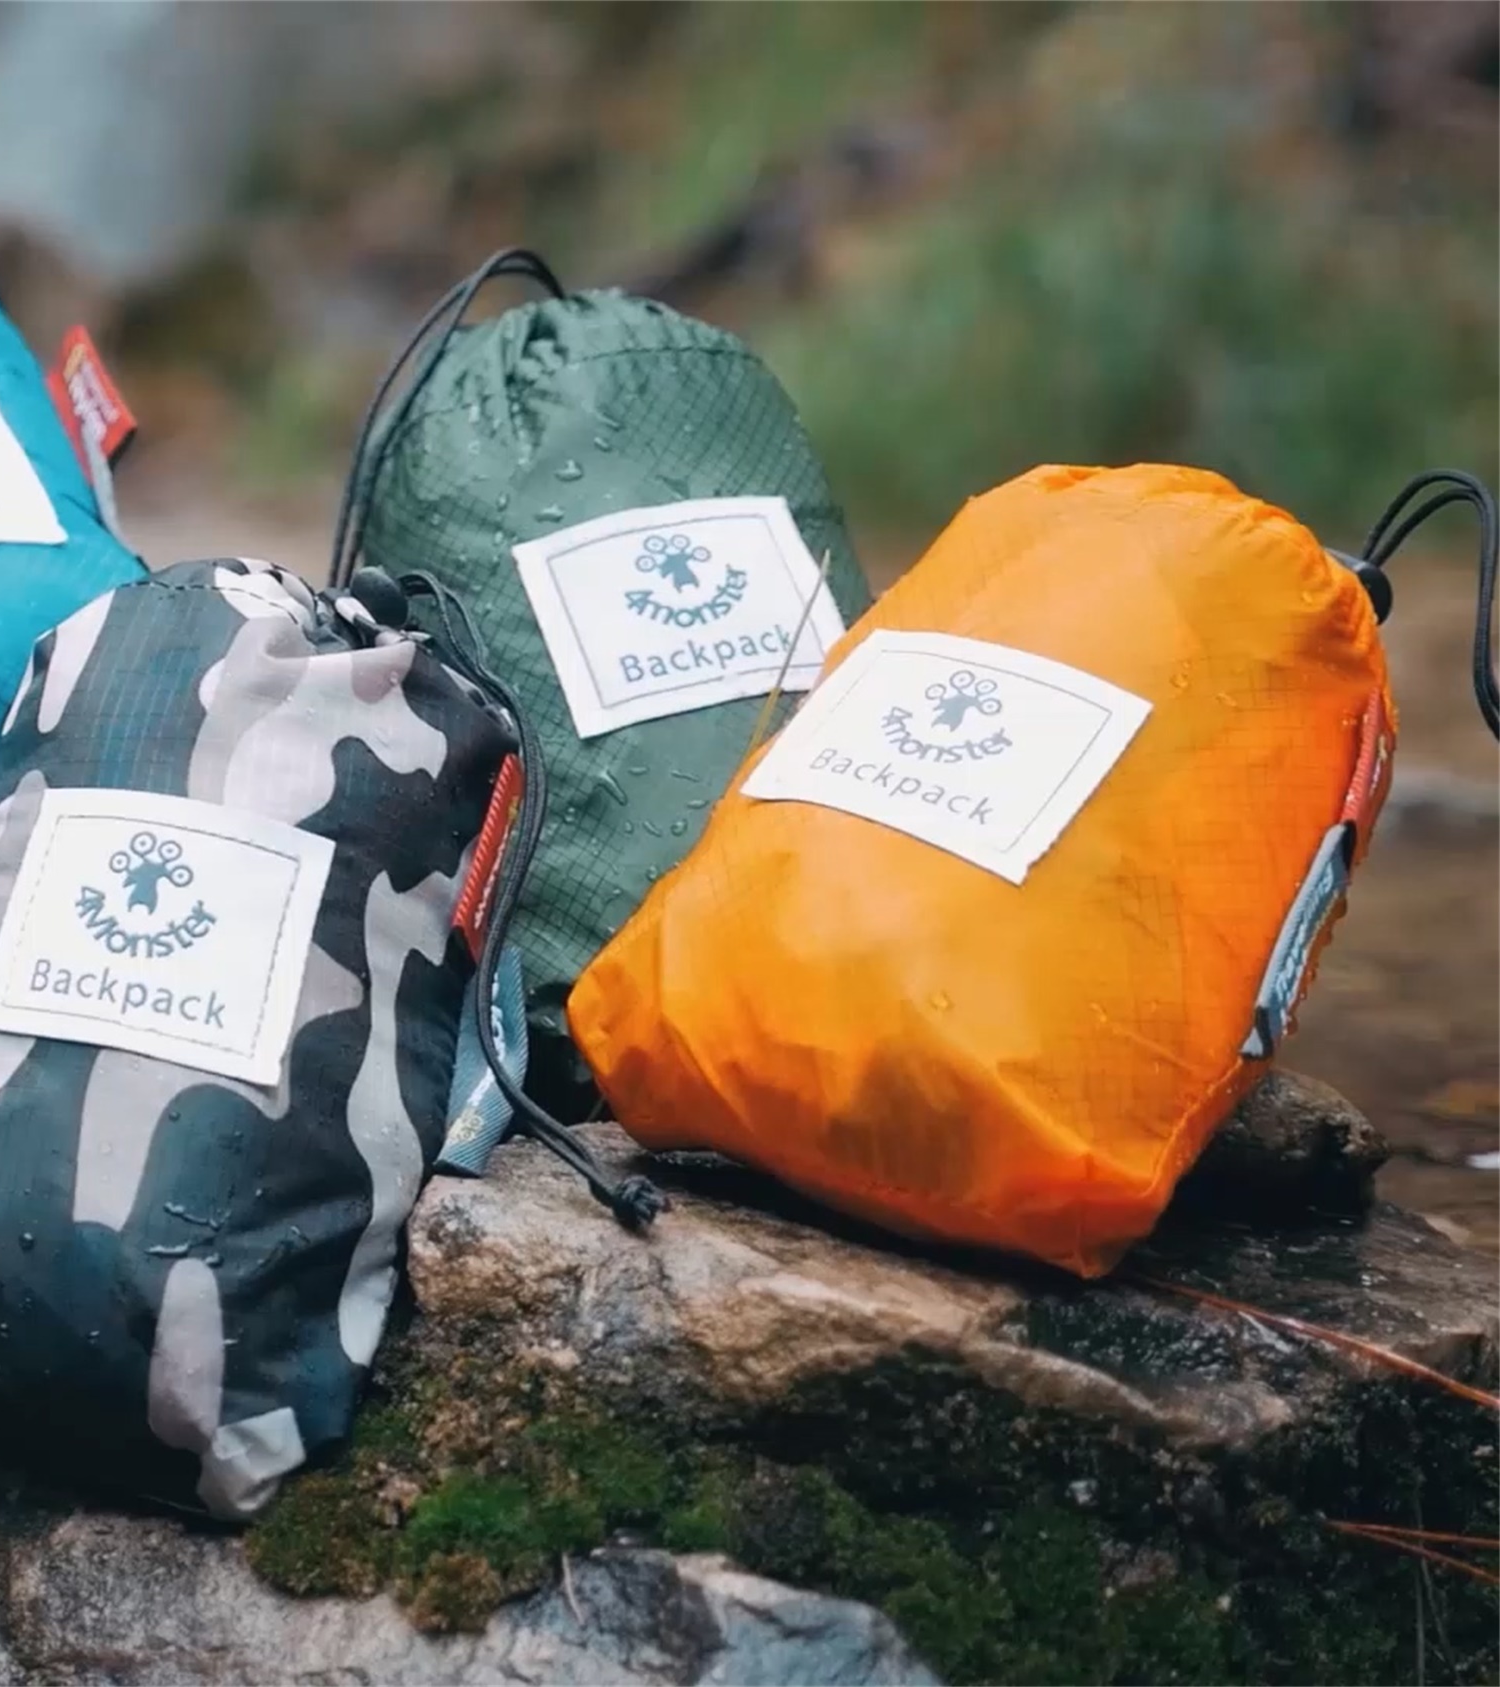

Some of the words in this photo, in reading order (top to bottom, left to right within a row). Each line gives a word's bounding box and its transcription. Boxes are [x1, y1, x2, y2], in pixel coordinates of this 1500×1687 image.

[619, 624, 793, 684] Backpack
[809, 748, 996, 826] Backpack
[30, 958, 227, 1029] Backpack
